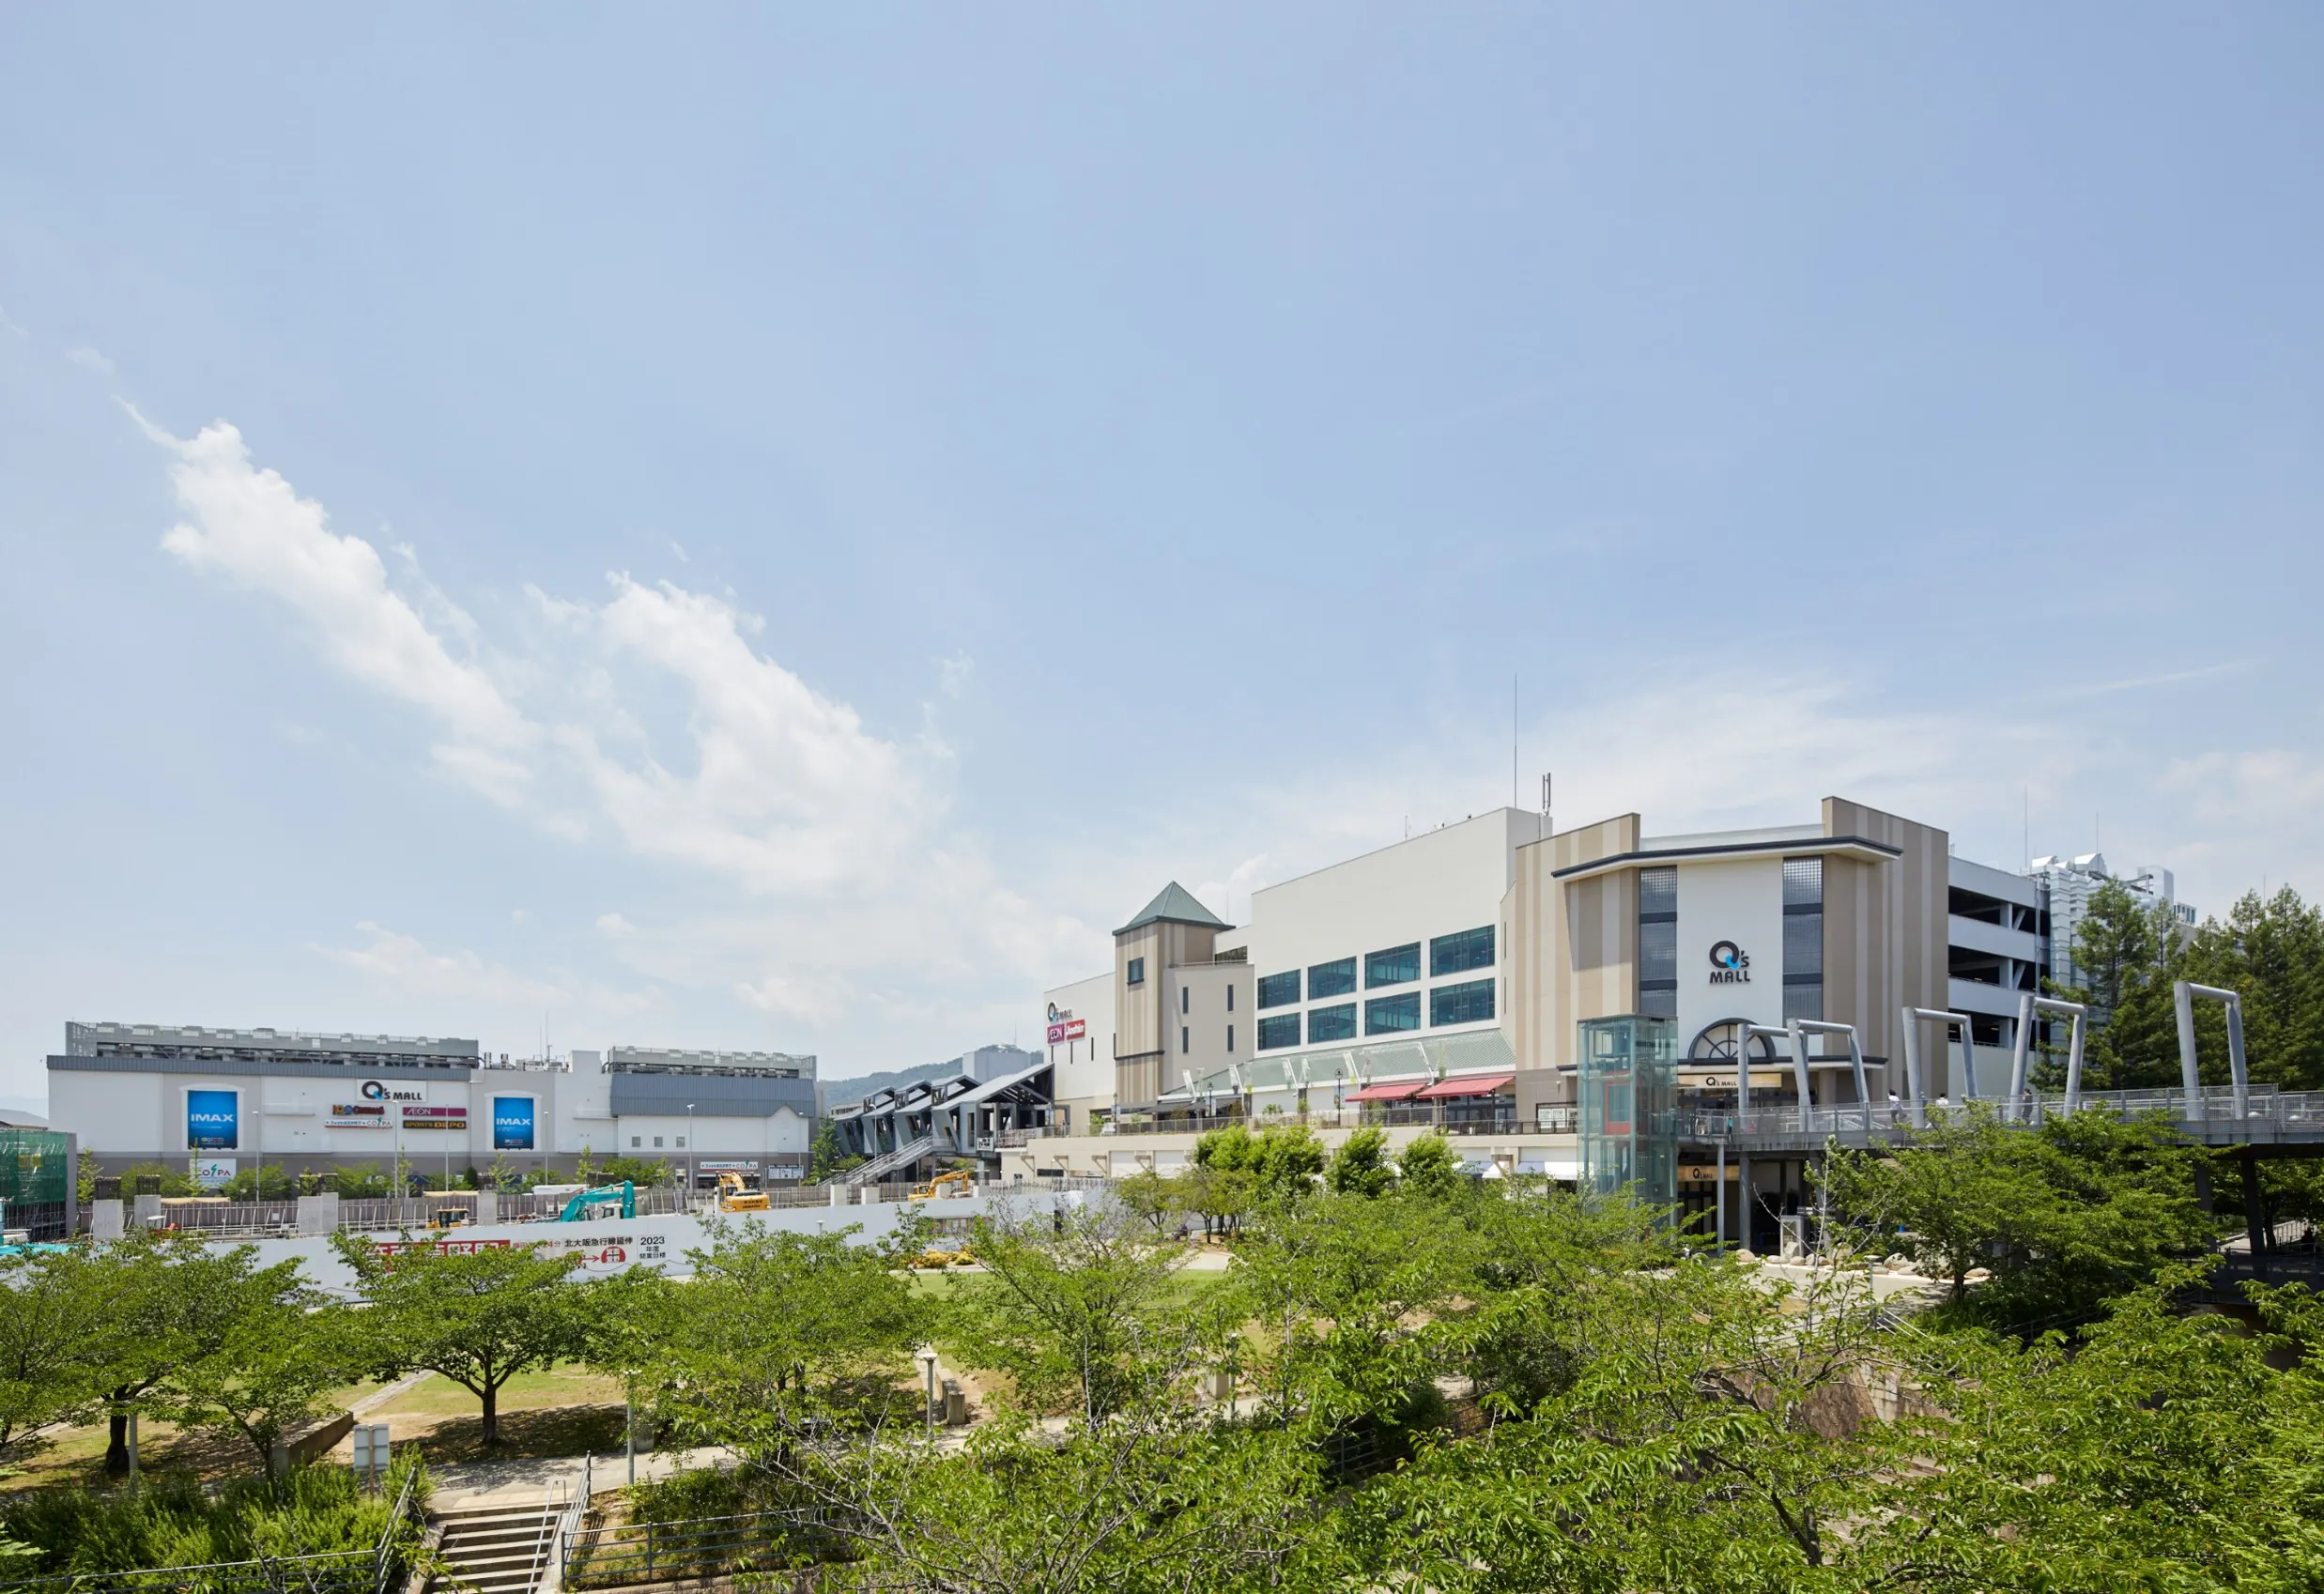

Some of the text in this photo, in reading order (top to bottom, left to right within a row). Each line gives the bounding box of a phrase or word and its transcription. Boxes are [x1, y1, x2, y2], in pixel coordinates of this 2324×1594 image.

[1709, 940, 1750, 970] Q's
[1709, 971, 1750, 983] MALL
[362, 1081, 423, 1100] Q's MALL
[191, 1113, 234, 1122] IMAX
[640, 1236, 665, 1246] 2023
